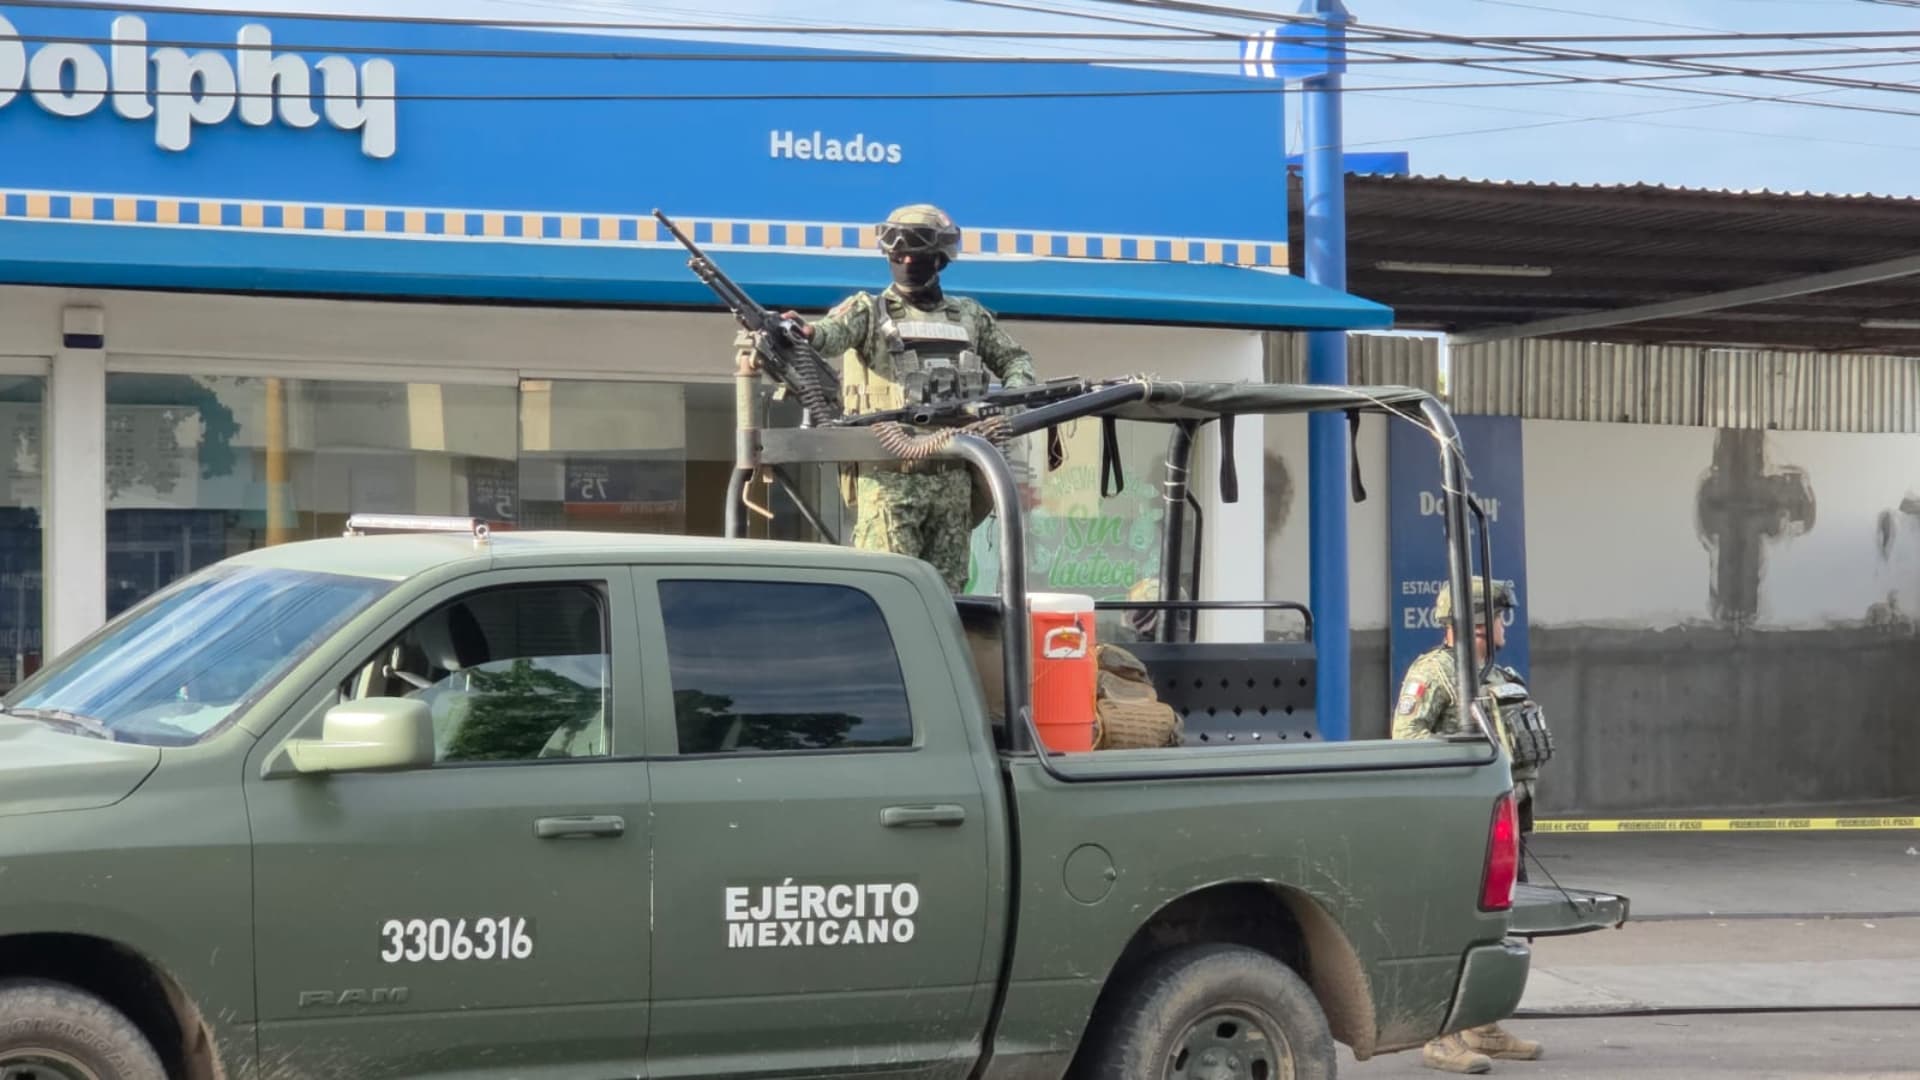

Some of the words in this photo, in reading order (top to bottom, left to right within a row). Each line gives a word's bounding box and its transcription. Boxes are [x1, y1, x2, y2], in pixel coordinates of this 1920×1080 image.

[770, 130, 902, 163] Helados
[1064, 503, 1122, 551] Sin
[725, 877, 919, 921] EJÉRCITO
[381, 917, 533, 963] 3306316
[728, 918, 915, 948] MEXICANO
[299, 987, 409, 1007] RAM
